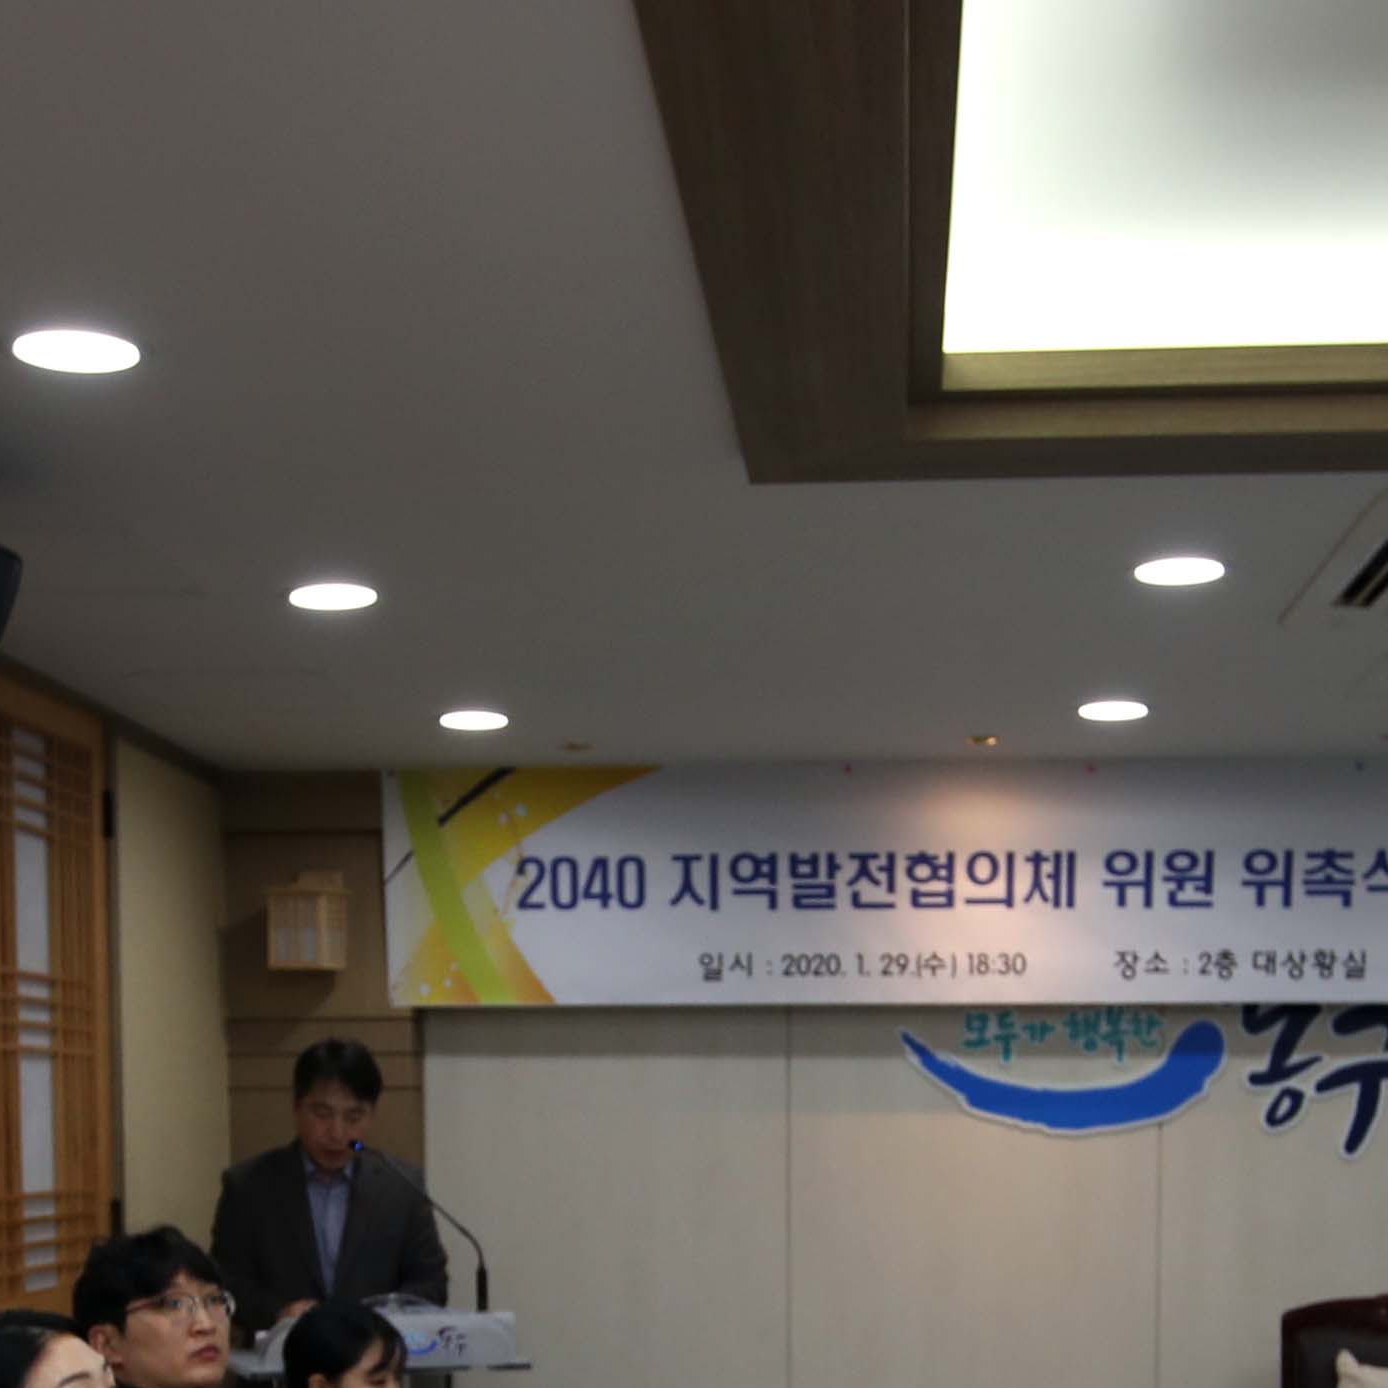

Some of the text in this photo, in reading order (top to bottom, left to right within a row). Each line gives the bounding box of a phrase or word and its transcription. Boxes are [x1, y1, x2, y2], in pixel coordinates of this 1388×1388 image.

[515, 855, 647, 911] 2040
[670, 850, 1077, 911] 지역발전협의체
[1102, 848, 1215, 909] 위원
[698, 952, 753, 983] 일시
[781, 954, 844, 977] 2020.
[966, 952, 1027, 977] 18:30
[1113, 949, 1368, 981] 장소 2층 대상황실
[963, 1011, 1055, 1063] 모두가
